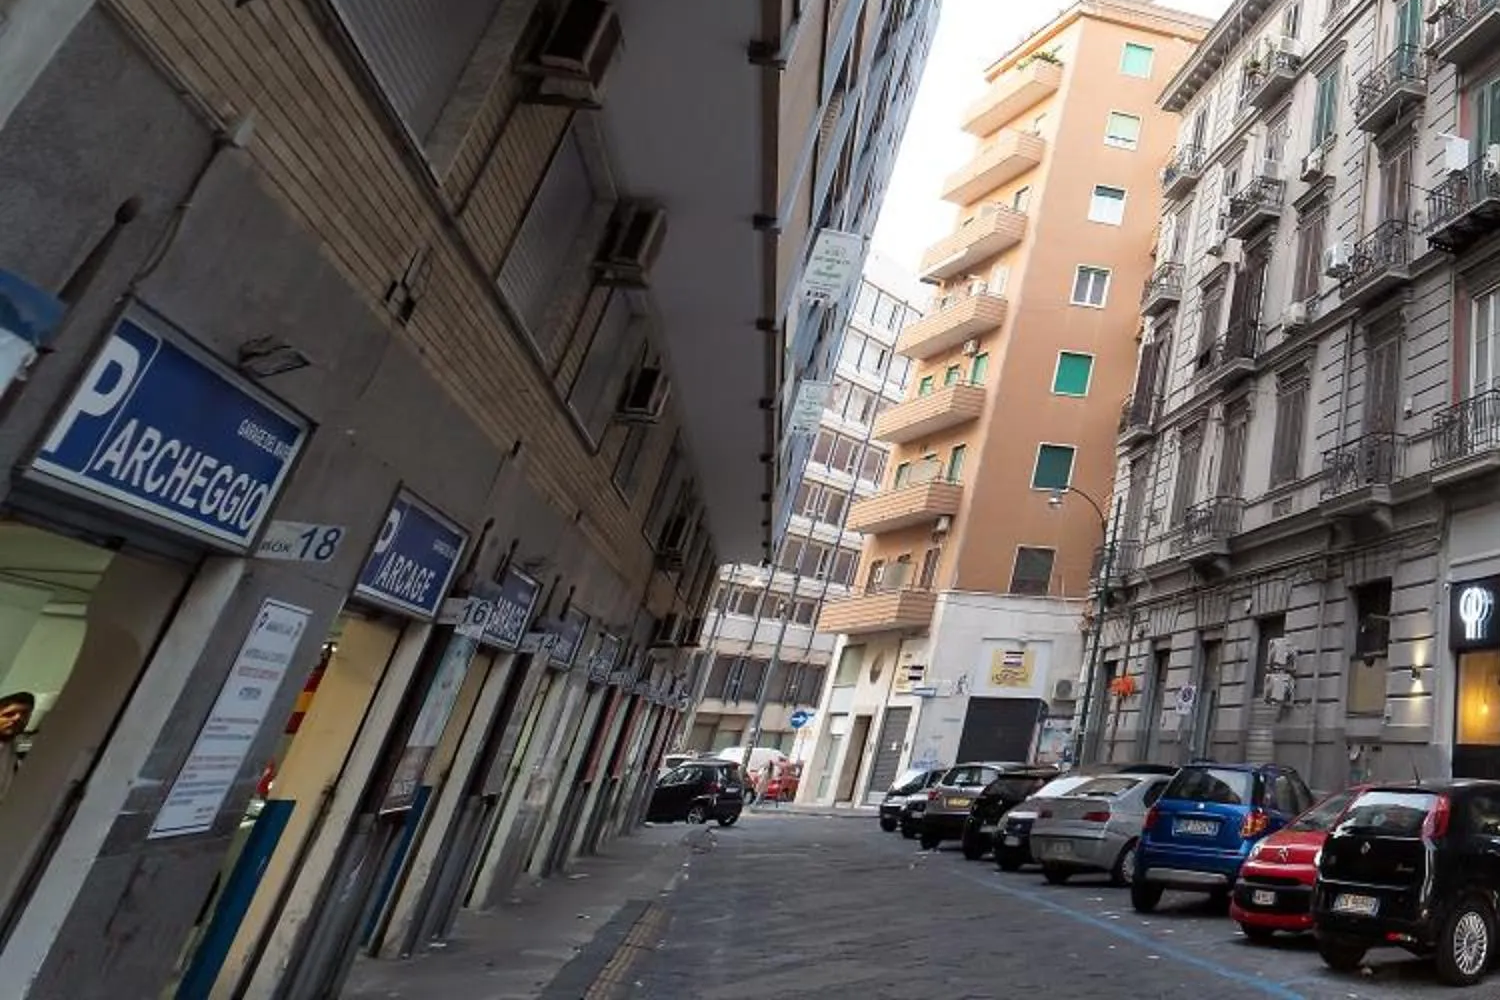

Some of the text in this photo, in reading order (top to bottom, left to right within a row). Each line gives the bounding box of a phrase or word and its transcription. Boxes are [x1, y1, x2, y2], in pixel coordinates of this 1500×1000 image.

[94, 418, 271, 531] ARCHEGGIO
[299, 526, 342, 562] 18
[462, 601, 489, 626] 16
